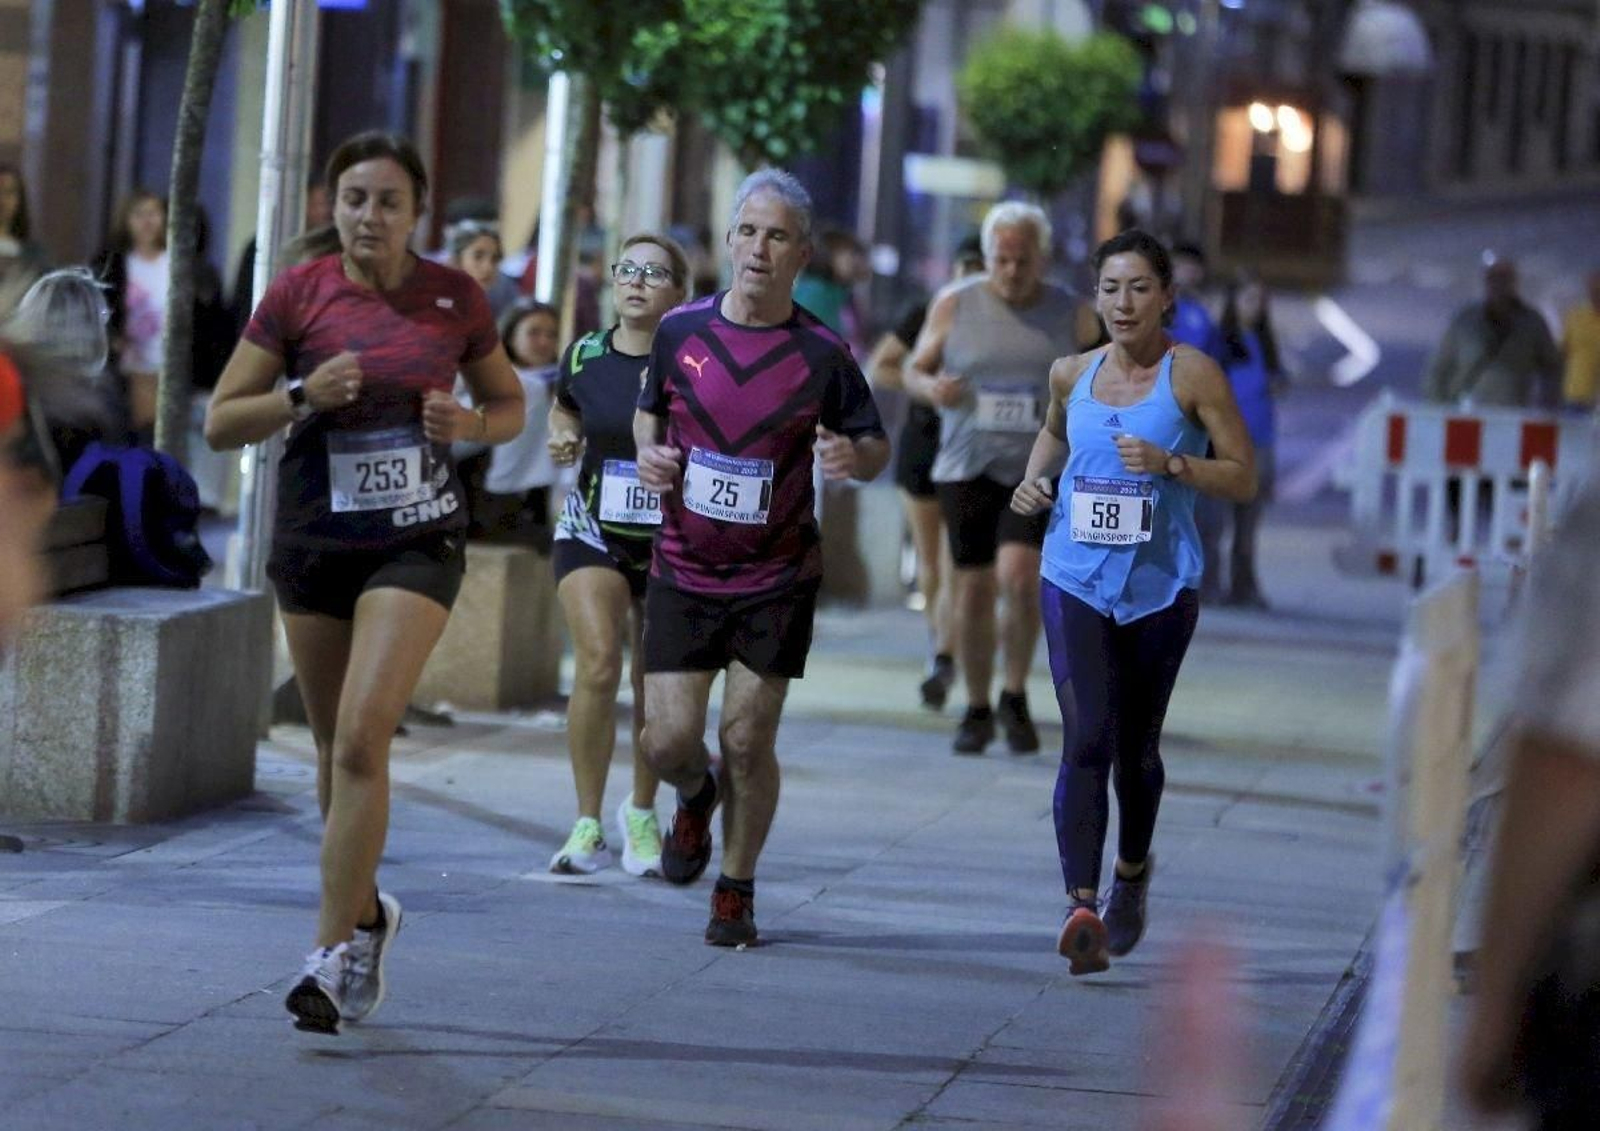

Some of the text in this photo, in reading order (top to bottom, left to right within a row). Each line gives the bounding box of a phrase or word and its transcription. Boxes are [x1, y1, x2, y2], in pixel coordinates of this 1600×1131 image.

[355, 458, 408, 494] 253
[626, 486, 659, 510] 166
[709, 478, 740, 508] 25
[392, 492, 459, 527] CNC
[1091, 502, 1120, 529] 58
